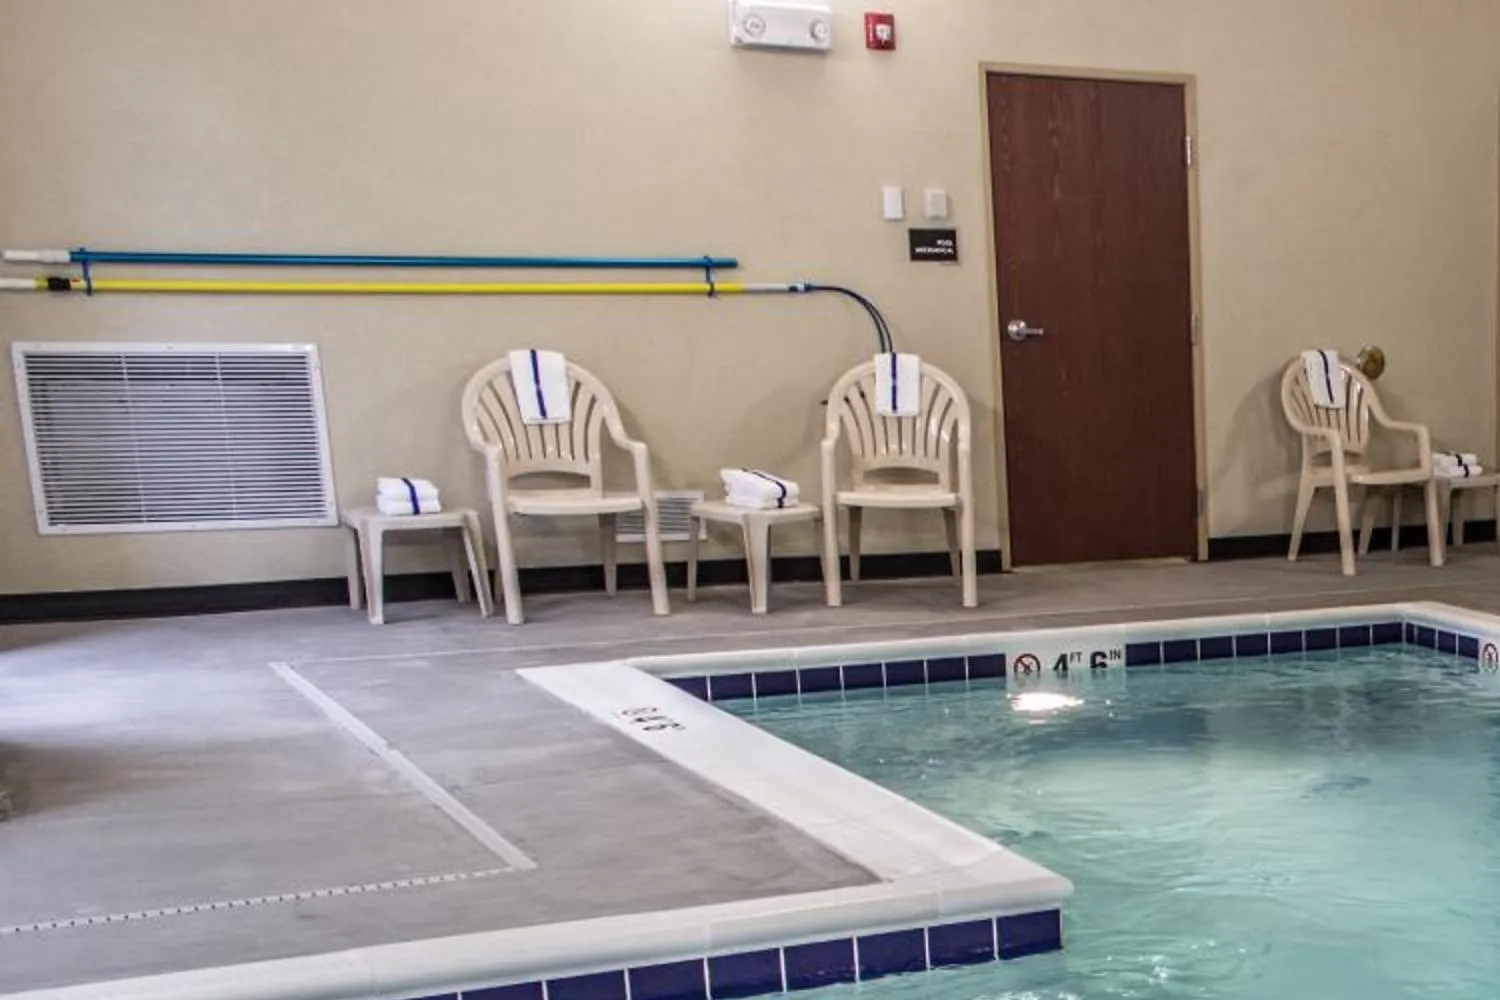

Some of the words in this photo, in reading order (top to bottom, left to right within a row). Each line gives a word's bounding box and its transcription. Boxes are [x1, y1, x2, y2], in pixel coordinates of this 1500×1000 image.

[1053, 653, 1068, 671] 4
[1069, 652, 1083, 664] FT
[1109, 649, 1121, 660] IN
